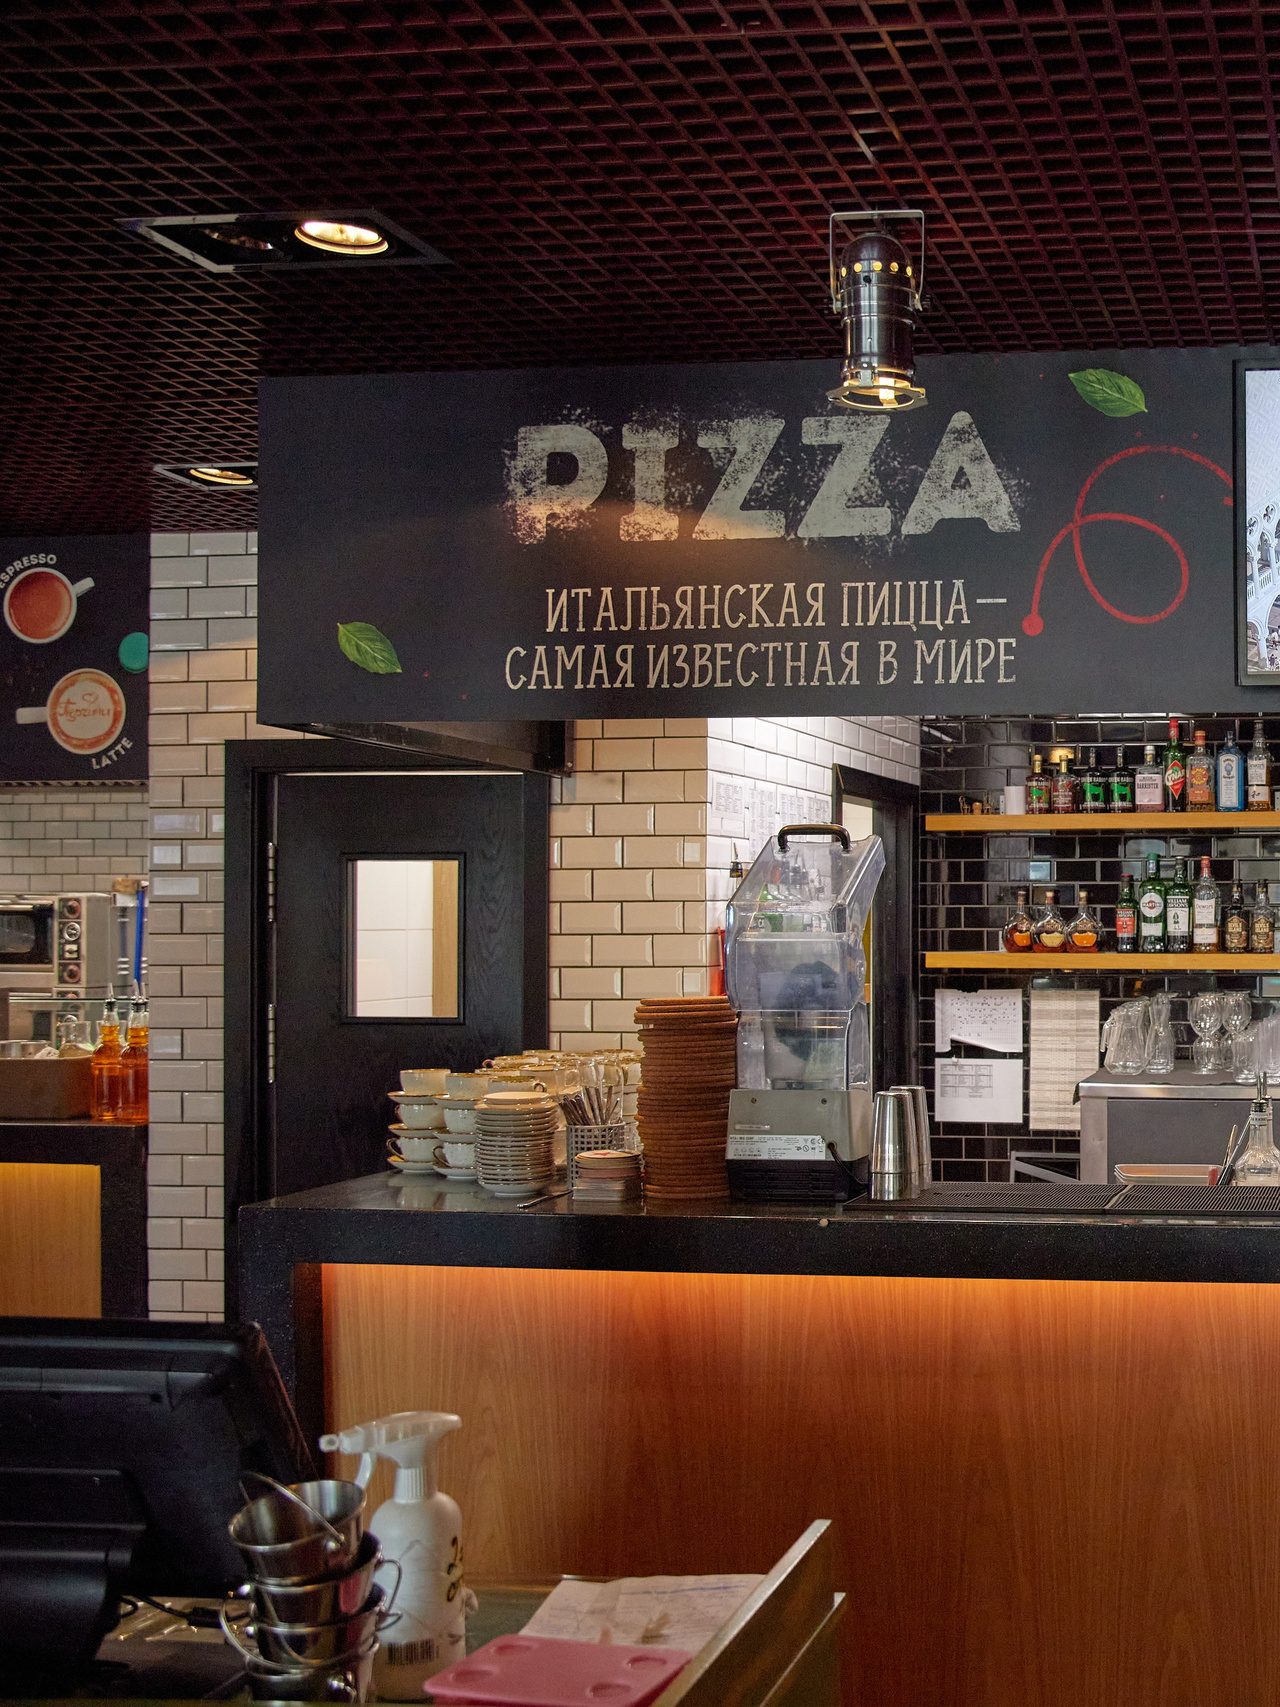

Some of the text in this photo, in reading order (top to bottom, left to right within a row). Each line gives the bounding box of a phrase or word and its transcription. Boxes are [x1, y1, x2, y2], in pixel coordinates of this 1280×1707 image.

[510, 410, 1022, 546] PIZZA
[546, 583, 826, 632] ИТАЛЬЯНСКАЯ
[505, 638, 1016, 690] САМАЯ ИЗВЕСТНАЯ В МИРЕ
[91, 736, 133, 770] LATTE
